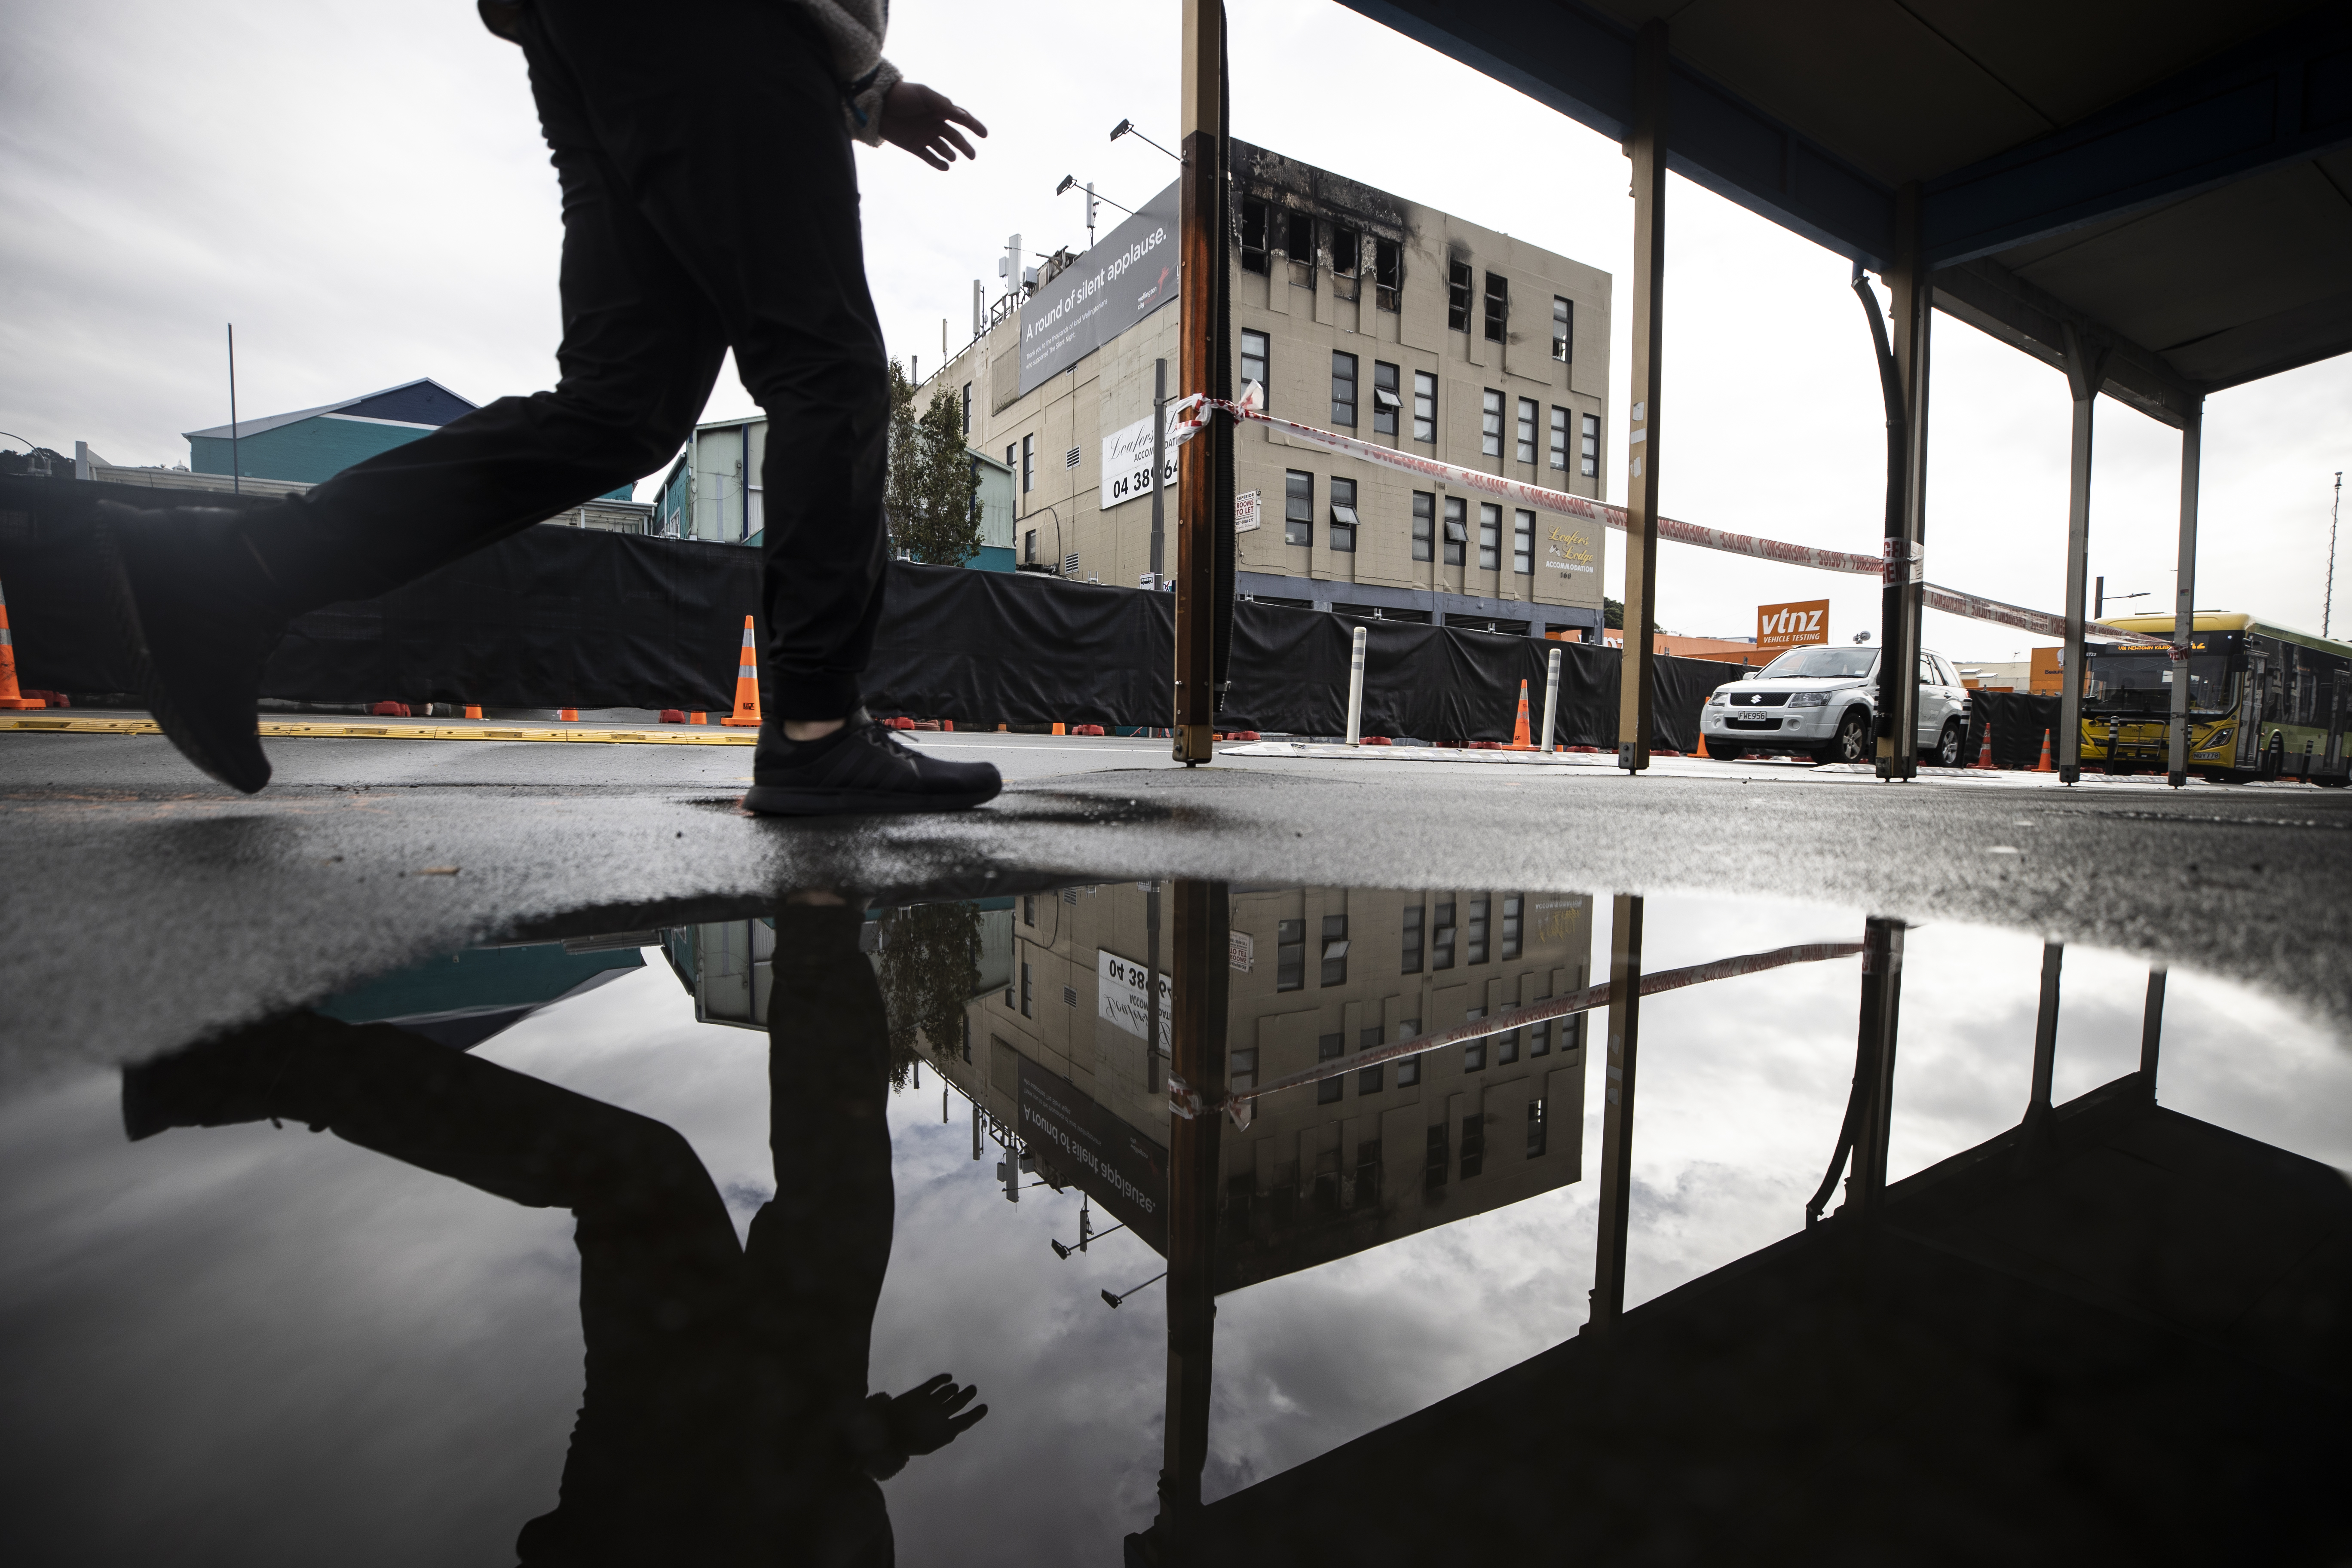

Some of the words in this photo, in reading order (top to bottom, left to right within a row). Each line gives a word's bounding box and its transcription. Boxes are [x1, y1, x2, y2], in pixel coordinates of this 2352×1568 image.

[1026, 324, 1033, 342] A
[1035, 299, 1062, 335] round
[1064, 289, 1075, 312] of
[1077, 268, 1105, 304] silent
[1107, 227, 1166, 280] applause.
[1138, 286, 1157, 303] wellington
[1026, 349, 1035, 360] Thank
[1052, 326, 1069, 342] thousands
[1082, 298, 1108, 321] Wellingtonians
[1033, 351, 1049, 365] supported
[1056, 339, 1065, 350] Silent
[1066, 331, 1076, 343] Night.
[1113, 477, 1128, 498] 04
[1237, 499, 1254, 508] ROOMS
[1562, 544, 1593, 566] Lodge
[1546, 560, 1593, 573] ACCOMMODATION
[1762, 608, 1823, 635] vtnz
[1792, 633, 1820, 641] TESTING
